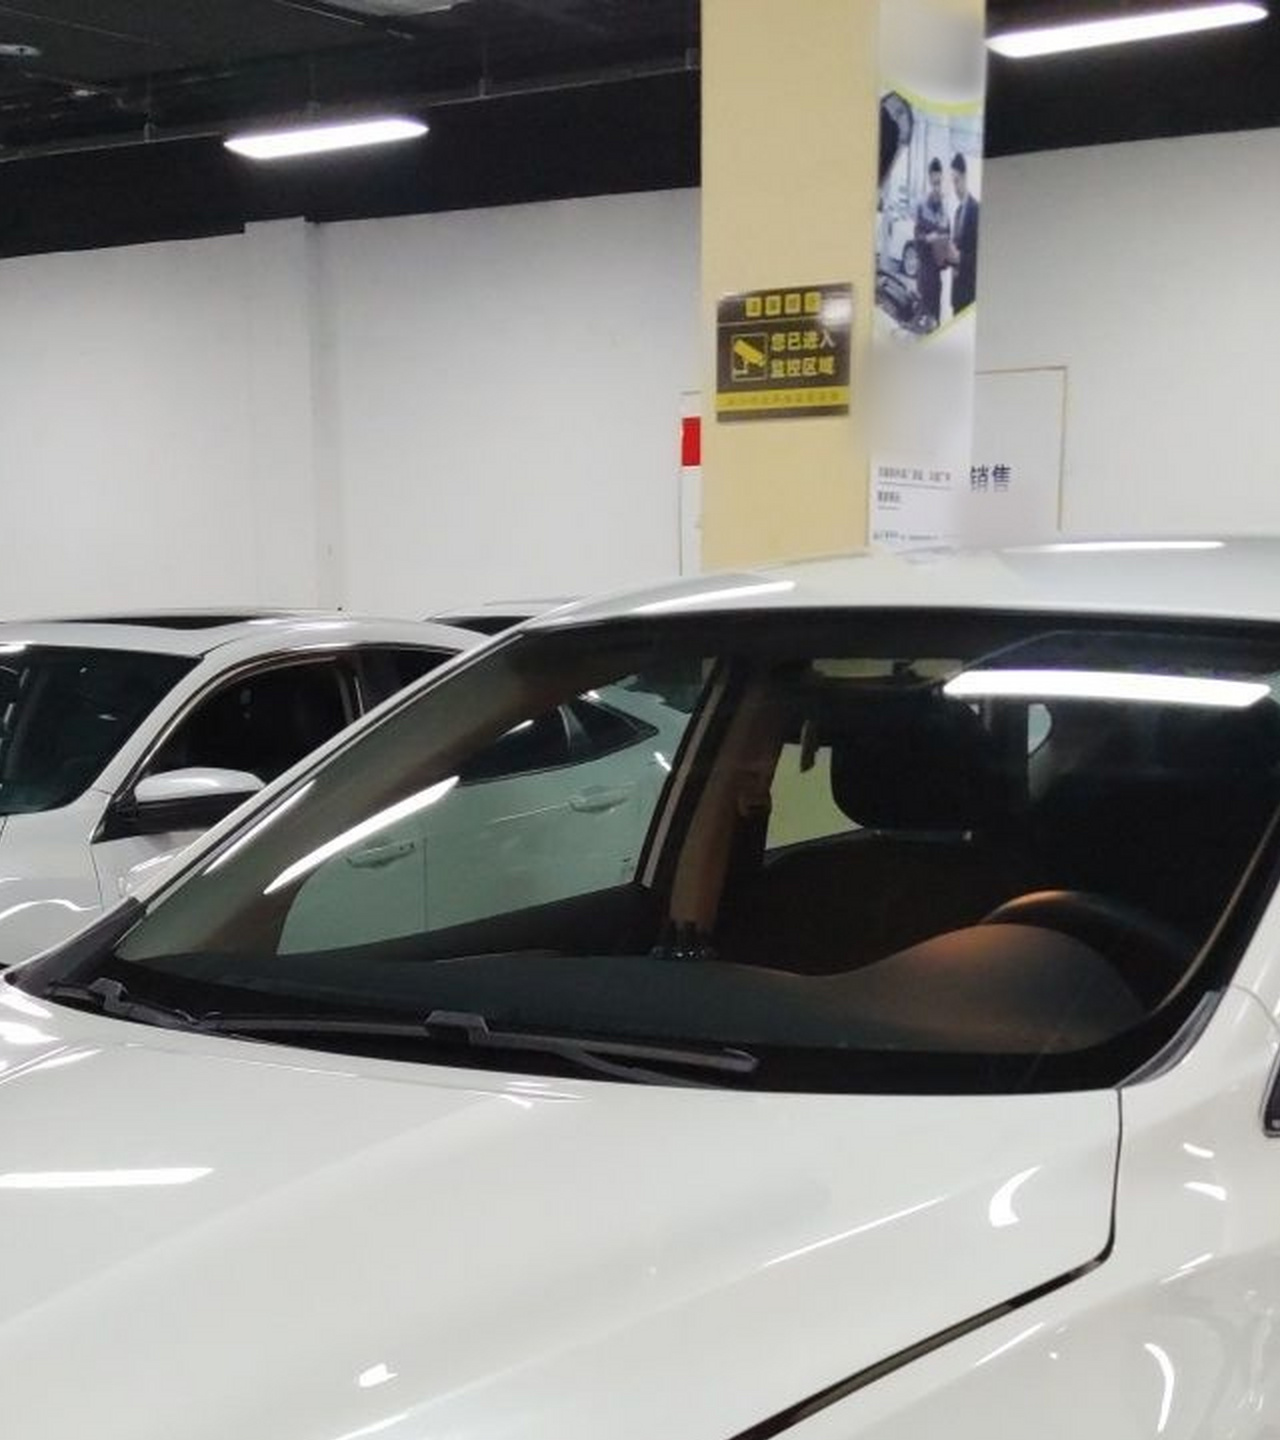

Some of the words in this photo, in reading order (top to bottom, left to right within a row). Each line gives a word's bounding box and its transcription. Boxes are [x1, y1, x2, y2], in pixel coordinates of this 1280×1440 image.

[771, 330, 836, 352] 您已进入
[771, 356, 835, 379] 监控区域
[970, 464, 1011, 493] 销售
